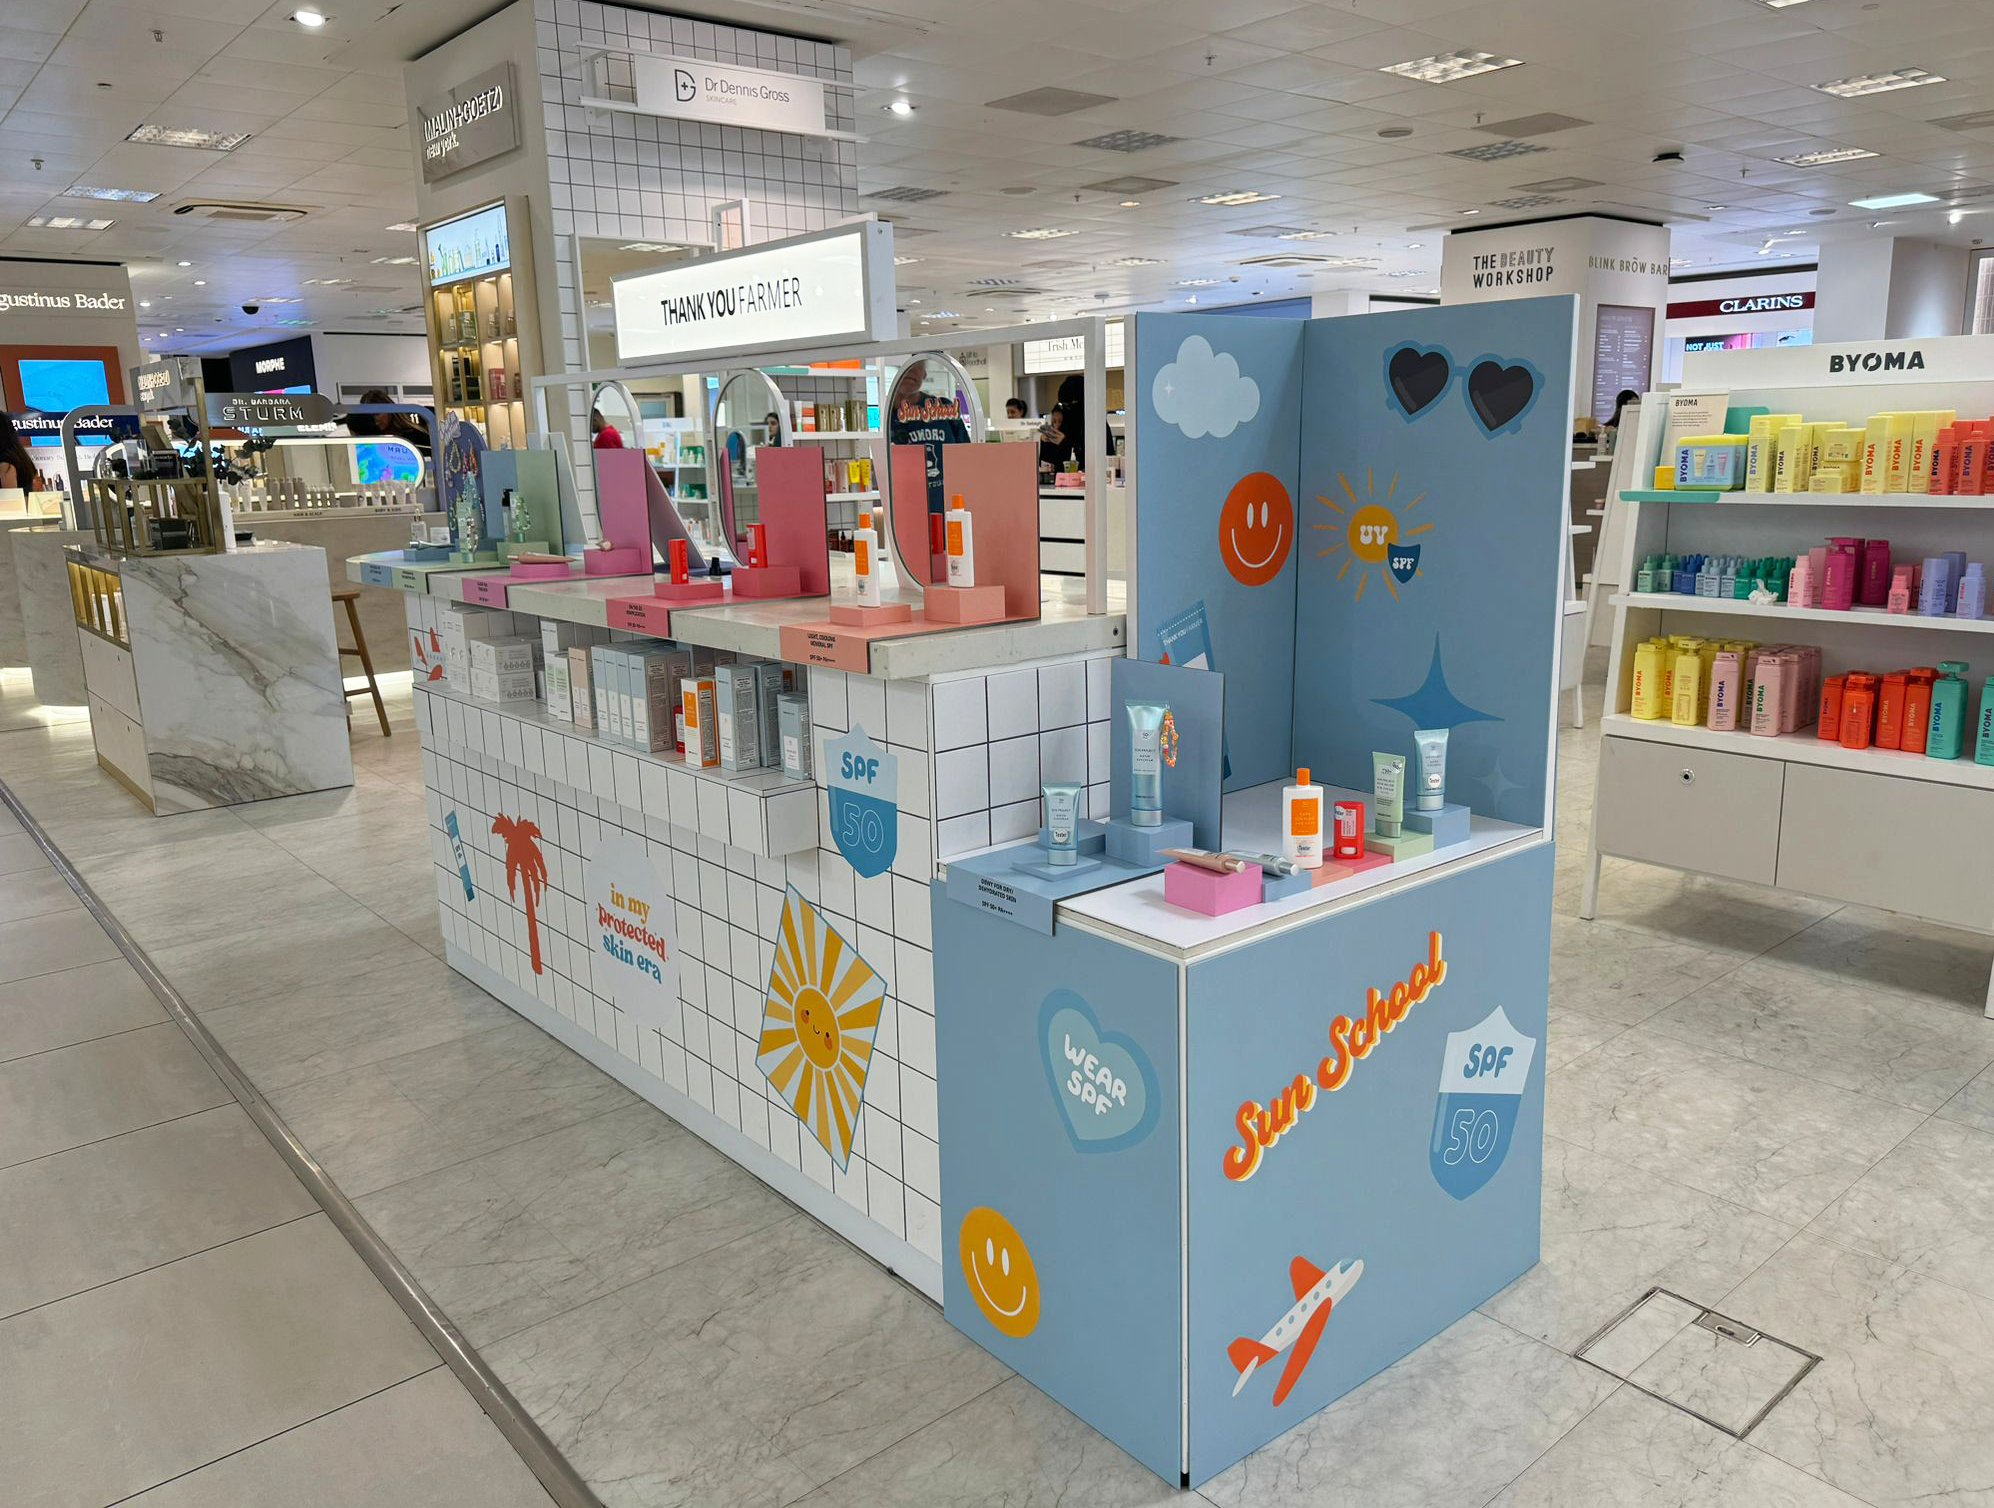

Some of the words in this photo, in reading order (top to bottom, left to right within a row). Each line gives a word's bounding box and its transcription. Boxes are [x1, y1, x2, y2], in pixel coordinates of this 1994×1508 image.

[705, 77, 718, 92] Dr
[720, 79, 759, 98] Dennis
[760, 85, 790, 103] Gross
[705, 94, 737, 106] SKINCARE
[1473, 254, 1497, 271] THE
[1500, 247, 1555, 268] BEAUTY
[1588, 255, 1616, 271] BLINK
[1650, 263, 1669, 277] BAR
[1473, 266, 1554, 289] WORKSHOP
[75, 292, 125, 310] Bader
[661, 293, 706, 326] THANK
[707, 287, 736, 319] YOU
[738, 276, 803, 315] FARMER
[1719, 295, 1804, 314] CLARINS
[1048, 339, 1068, 352] Trish
[1686, 342, 1703, 352] NOT
[1703, 341, 1724, 352] JUST
[255, 357, 286, 374] MORPHE
[1829, 350, 1925, 374] BYOMA
[222, 406, 305, 421] STURM
[897, 400, 922, 423] Sun
[921, 397, 961, 422] School
[1675, 398, 1699, 408] BYOMA
[1680, 449, 1689, 483] BYOMA
[1750, 444, 1759, 475] BYOMA
[1777, 450, 1785, 476] BYOMA
[1812, 446, 1820, 471] BYOMA
[1865, 443, 1876, 476] BYOMA
[1892, 438, 1902, 471] BYOMA
[1913, 438, 1923, 471] BYOMA
[1931, 449, 1940, 476] BYOMA
[1962, 445, 1973, 476] BYOMA
[1360, 525, 1389, 546] UV
[1392, 556, 1415, 571] SPF
[1635, 670, 1643, 697] BYOMA
[1664, 669, 1673, 697] BYOMA
[1717, 680, 1725, 708] BYOMA
[1756, 684, 1765, 712] BYOMA
[1881, 700, 1889, 724] BYOMA
[1908, 702, 1917, 727] BYOMA
[1932, 702, 1943, 732] BYOMA
[1982, 707, 1993, 738] BYOMA
[841, 751, 880, 785] SPF
[842, 802, 884, 853] 50
[610, 882, 625, 910] in
[628, 896, 651, 926] my
[598, 902, 667, 963] protected
[603, 934, 635, 966] skin
[636, 954, 662, 985] era
[1223, 1073, 1317, 1182] Sun
[1316, 930, 1448, 1092] School
[1463, 1043, 1514, 1079] SPF
[1064, 1033, 1127, 1107] WEAR
[1066, 1071, 1113, 1117] SPF
[1443, 1108, 1499, 1166] 50
